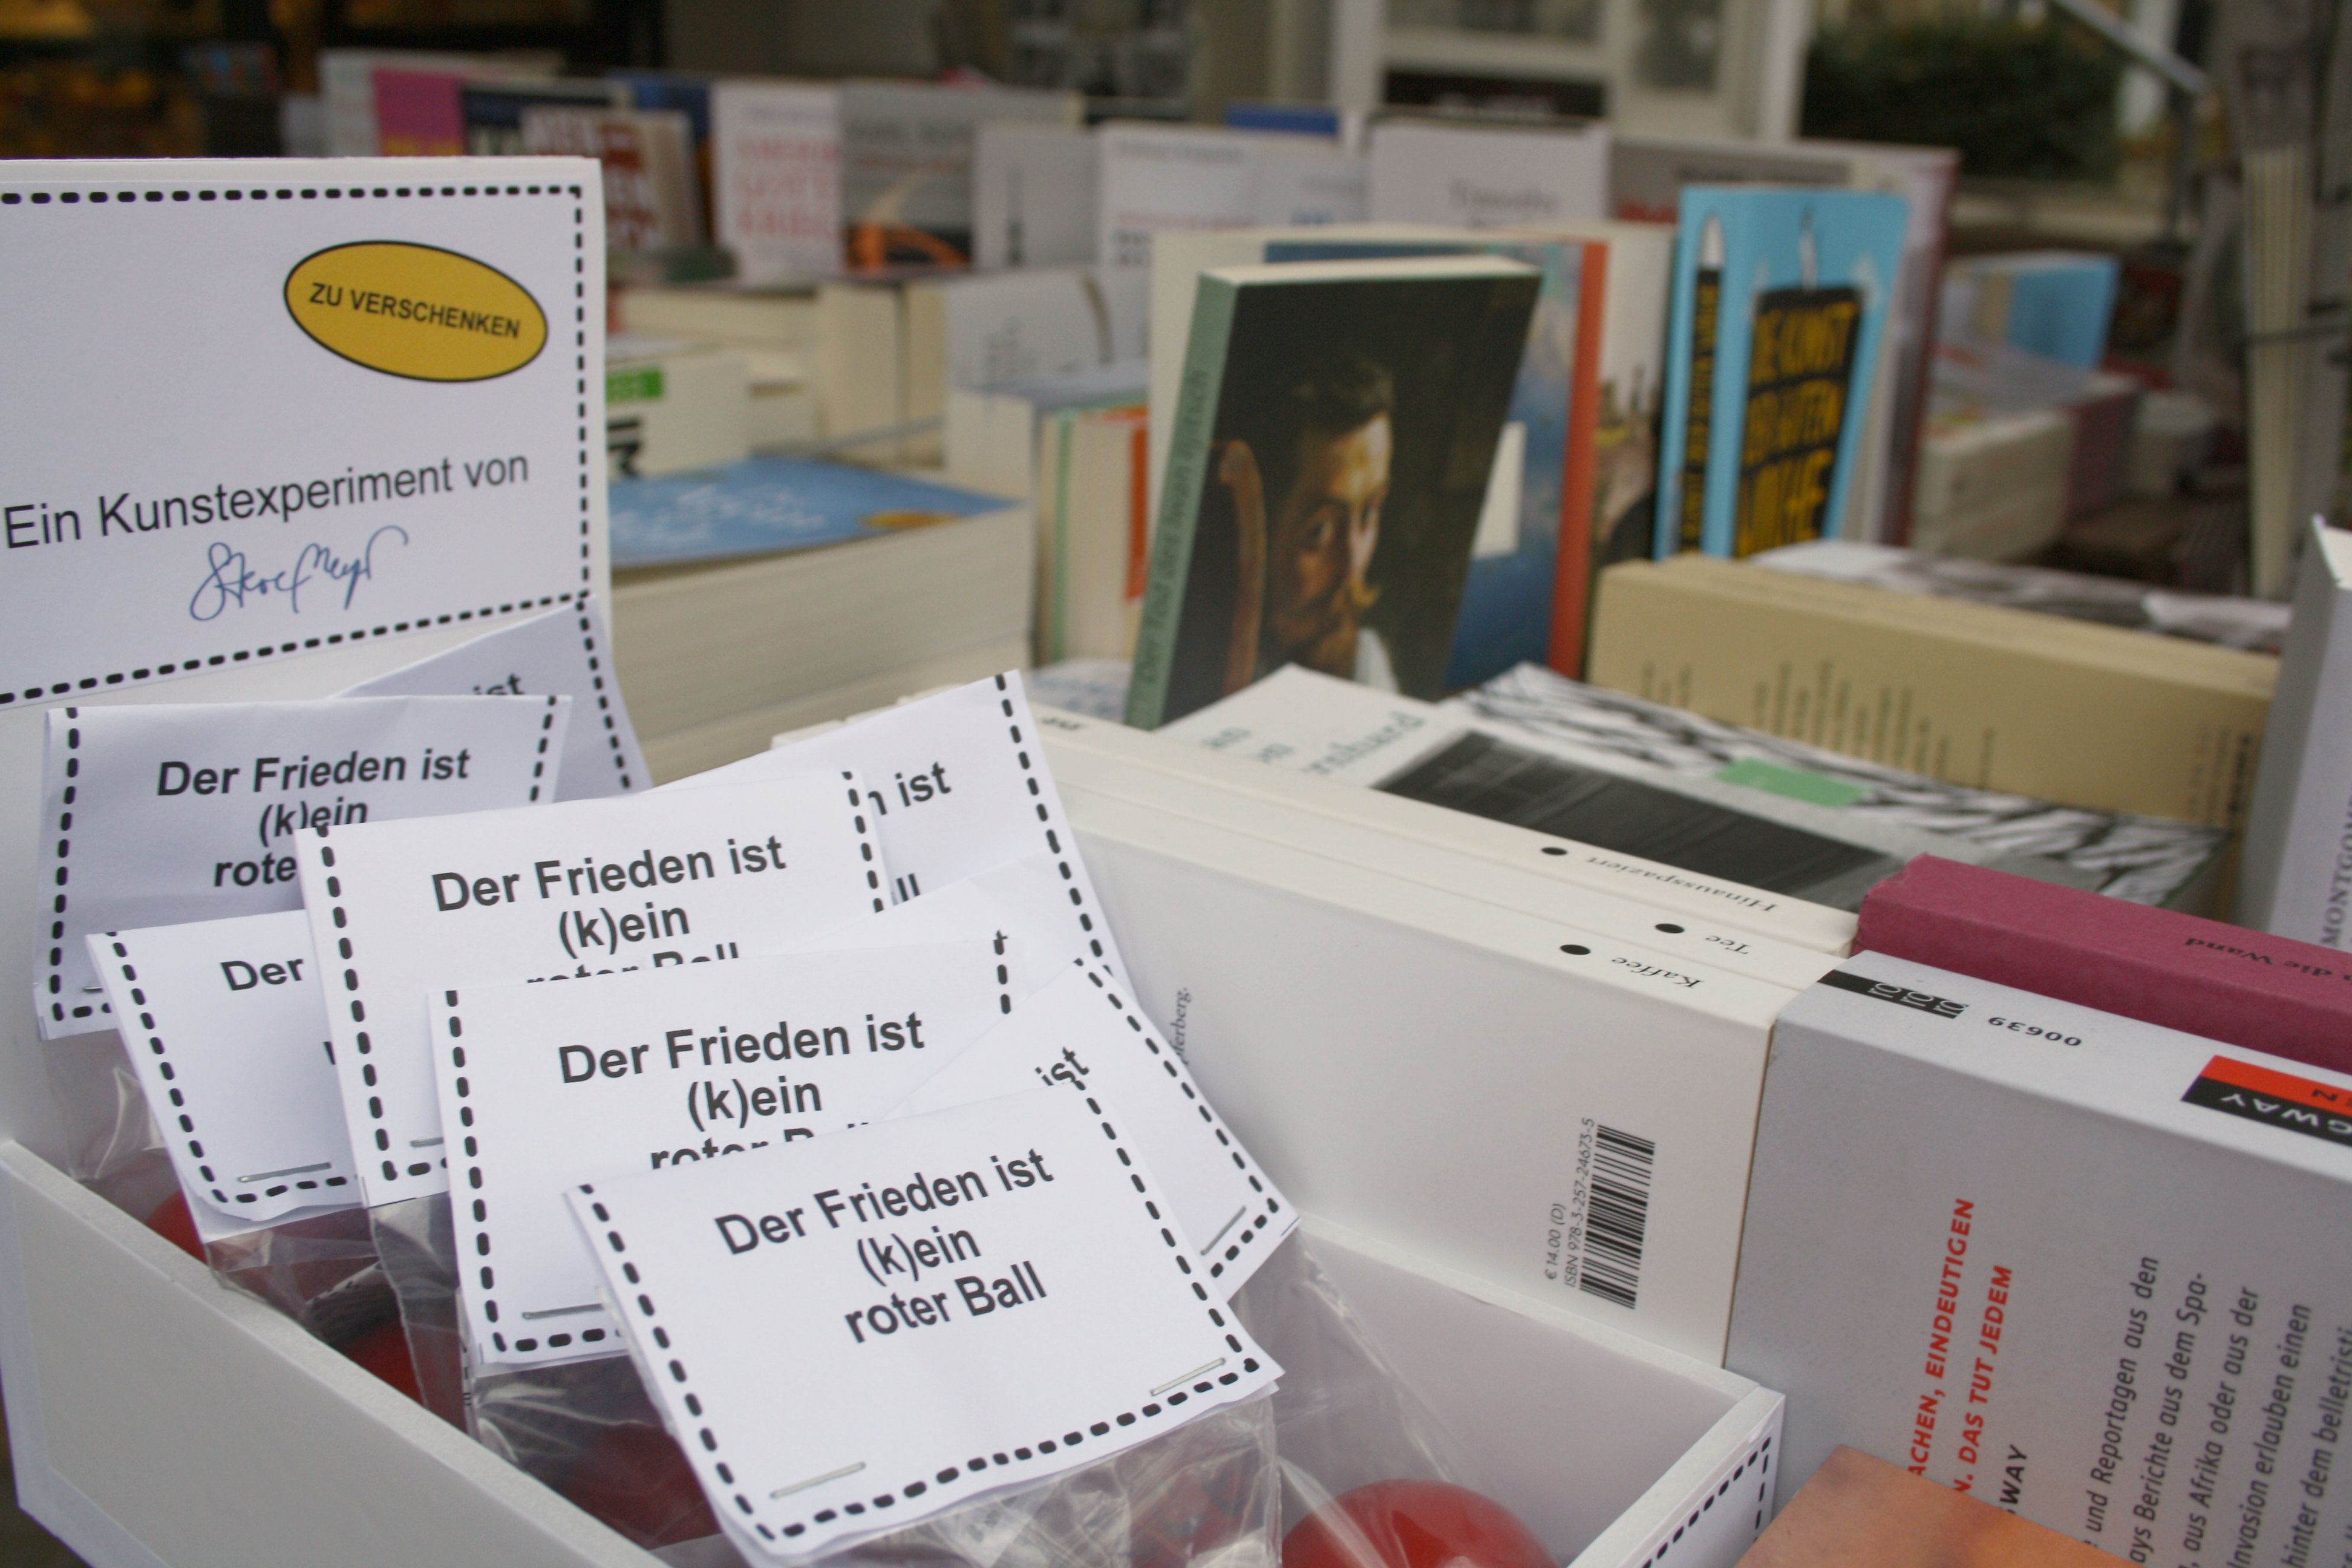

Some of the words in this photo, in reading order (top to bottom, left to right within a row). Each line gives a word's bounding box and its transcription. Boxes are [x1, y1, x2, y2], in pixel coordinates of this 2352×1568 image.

[309, 282, 344, 307] ZU
[350, 289, 521, 339] VERSCHENKEN
[4, 501, 81, 549] Ein
[99, 457, 453, 537] Kunstexperiment
[464, 454, 529, 488] von
[157, 761, 239, 796] Der
[252, 751, 406, 792] Frieden
[422, 748, 471, 780] ist
[895, 761, 952, 807] ist
[432, 869, 521, 912] Der
[535, 848, 714, 900] Frieden
[727, 835, 786, 875] ist
[1586, 855, 1779, 913] Hinausspaziert
[558, 901, 690, 959] (k)ein
[1704, 933, 1751, 956] Tee
[2184, 937, 2274, 966] Wand
[220, 958, 305, 991] Der
[1611, 956, 1705, 988] Kaffee
[2283, 959, 2334, 976] die
[558, 1044, 650, 1083] Der
[665, 1021, 850, 1068] Frieden
[864, 1011, 925, 1053] ist
[1988, 1016, 2082, 1047] 00639
[687, 1075, 822, 1133] (k)ein
[715, 1206, 806, 1255] Der
[814, 1171, 988, 1229] Frieden
[990, 1148, 1054, 1194] ist
[1550, 1203, 1567, 1226] (D)
[857, 1224, 981, 1286] (k)ein
[1546, 1228, 1562, 1267] 14.00
[1564, 1254, 1579, 1288] ISBN
[1544, 1268, 1558, 1281] €
[1925, 1198, 1975, 1380] EINDEUTIGEN
[2129, 1256, 2159, 1299] den
[2176, 1272, 2208, 1326] Spa-
[844, 1291, 950, 1344] roter
[954, 1259, 1048, 1318] Ball
[1979, 1264, 2013, 1355] JEDEM
[2229, 1285, 2259, 1327] der
[2124, 1307, 2148, 1350] aus
[2223, 1333, 2249, 1375] aus
[2164, 1330, 2196, 1381] dem
[1968, 1357, 1994, 1407] TUT
[2159, 1385, 2183, 1427] aus
[2207, 1380, 2236, 1434] oder
[2253, 1373, 2295, 1476] erlauben
[2276, 1302, 2311, 1369] einen
[1958, 1413, 1985, 1466] DAS
[2090, 1357, 2137, 1485] Reportagen
[1999, 1444, 2028, 1515] WAY
[2133, 1431, 2173, 1522] Berichte
[2187, 1440, 2224, 1509] Afrika
[2299, 1448, 2333, 1500] dem
[2085, 1489, 2109, 1534] und
[2183, 1512, 2207, 1553] aus
